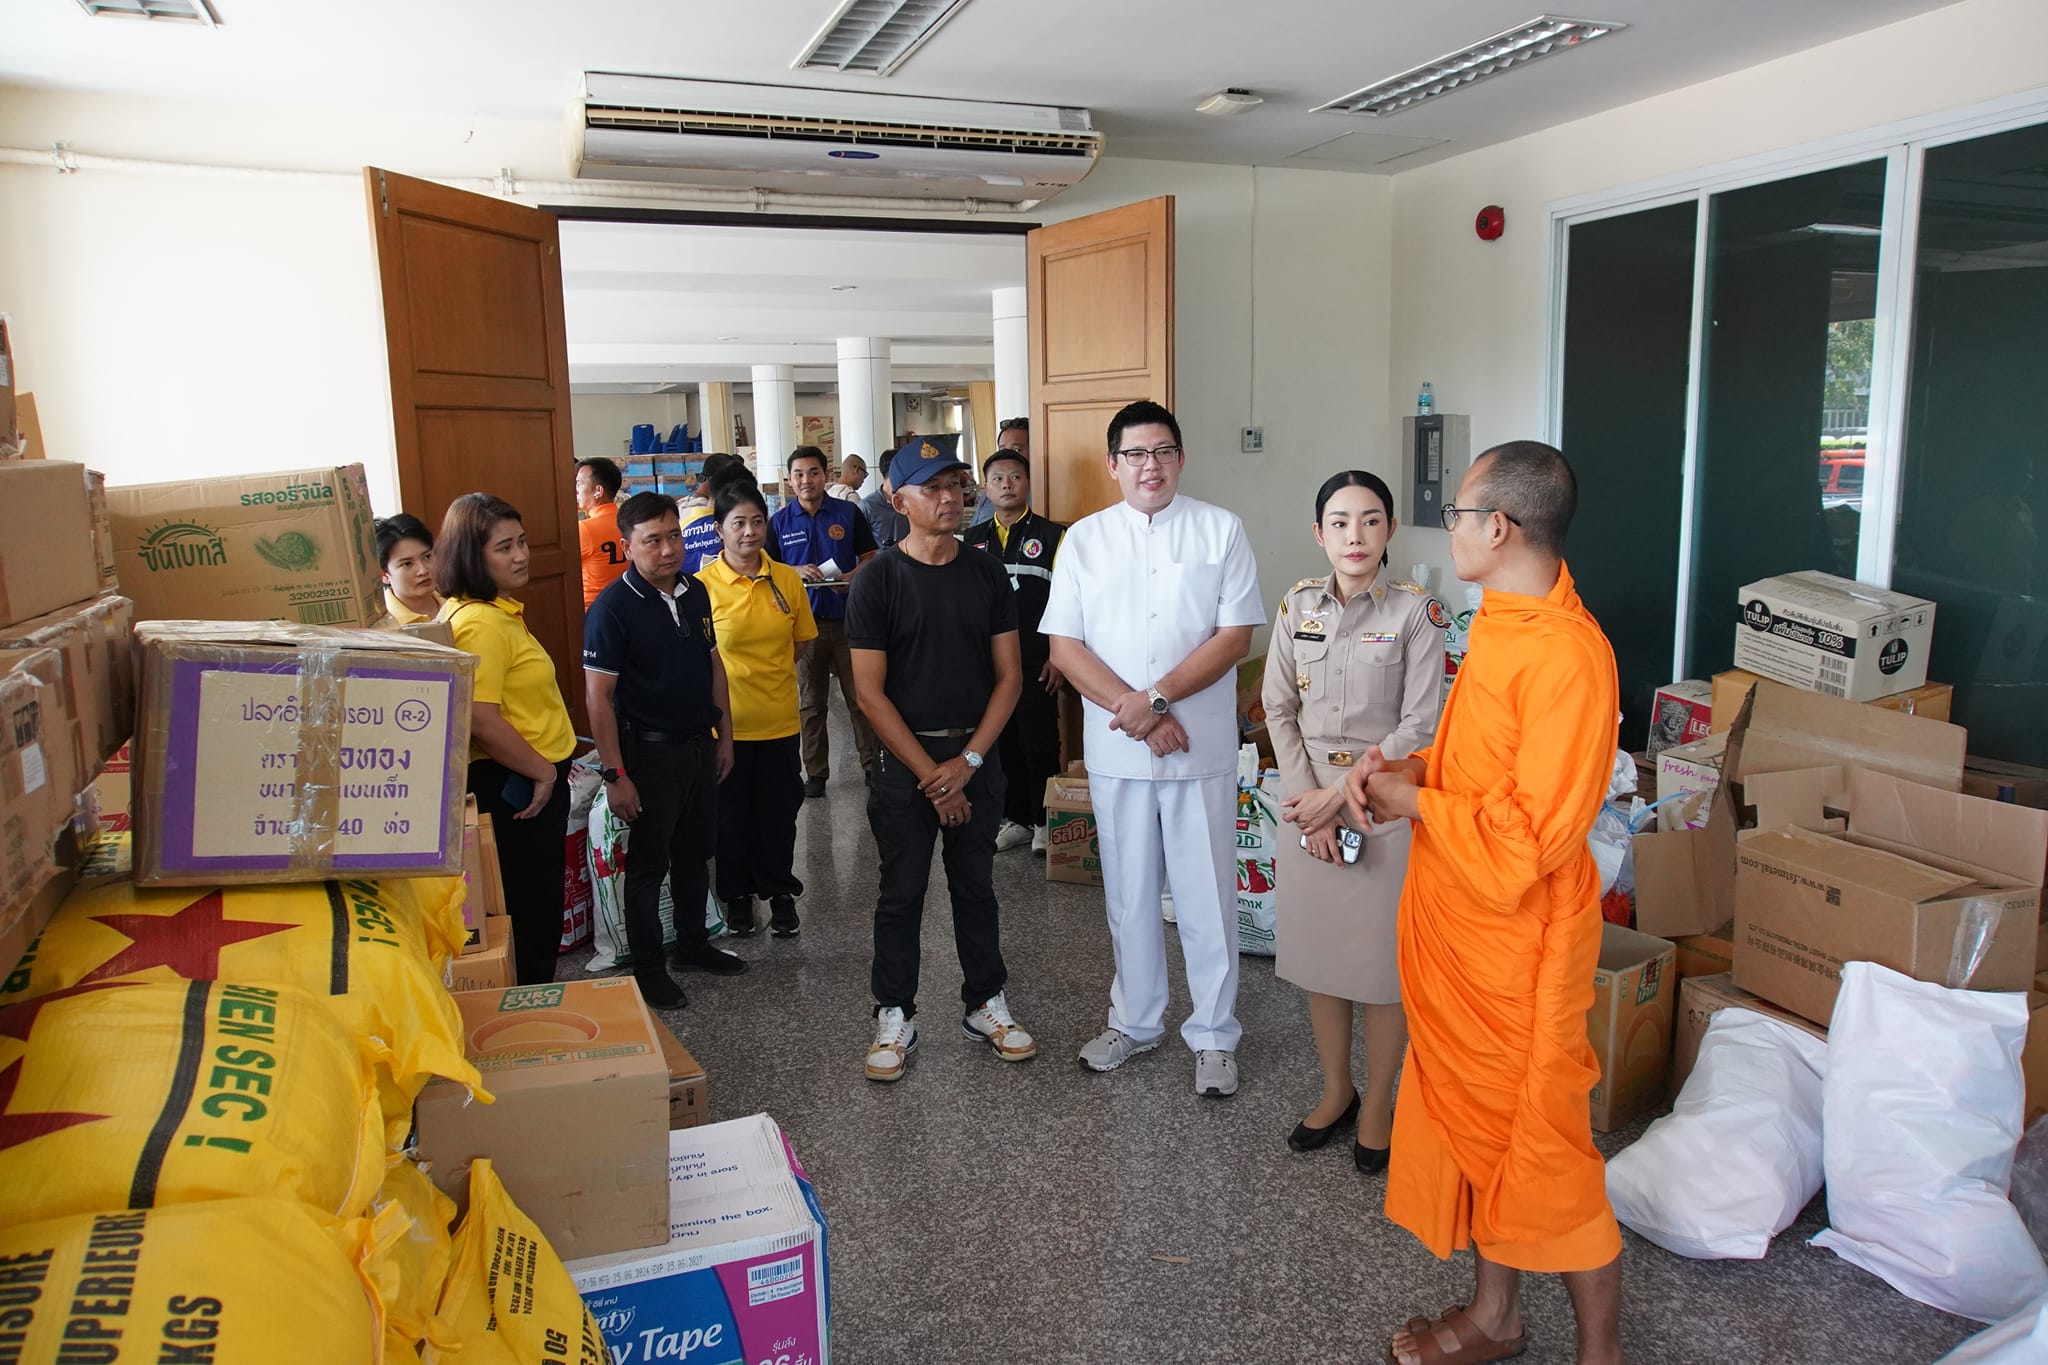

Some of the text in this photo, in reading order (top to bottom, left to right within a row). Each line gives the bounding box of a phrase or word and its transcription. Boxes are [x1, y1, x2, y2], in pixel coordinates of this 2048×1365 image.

[240, 482, 334, 506] รสออริจินัล
[288, 586, 350, 602] 320029210
[1746, 611, 1770, 625] TULIP
[1818, 630, 1844, 649] 10%
[1881, 651, 1906, 667] TULIP
[401, 710, 425, 722] R-2
[1663, 759, 1697, 777] fresh
[259, 782, 297, 798] ขนา
[338, 818, 363, 835] 40
[350, 894, 398, 935] SEC
[503, 996, 559, 1010] CAKE
[504, 988, 561, 1003] EURO
[183, 984, 279, 1154] BIEN SEC !
[676, 1174, 694, 1182] dry
[710, 1165, 738, 1176] Store
[720, 1212, 741, 1221] the
[744, 1205, 773, 1217] box.
[652, 1263, 665, 1276] EXP
[666, 1255, 704, 1272] 25.06.2027
[488, 1270, 499, 1286] AND
[544, 1328, 568, 1355] 50
[639, 1323, 722, 1361] Tape
